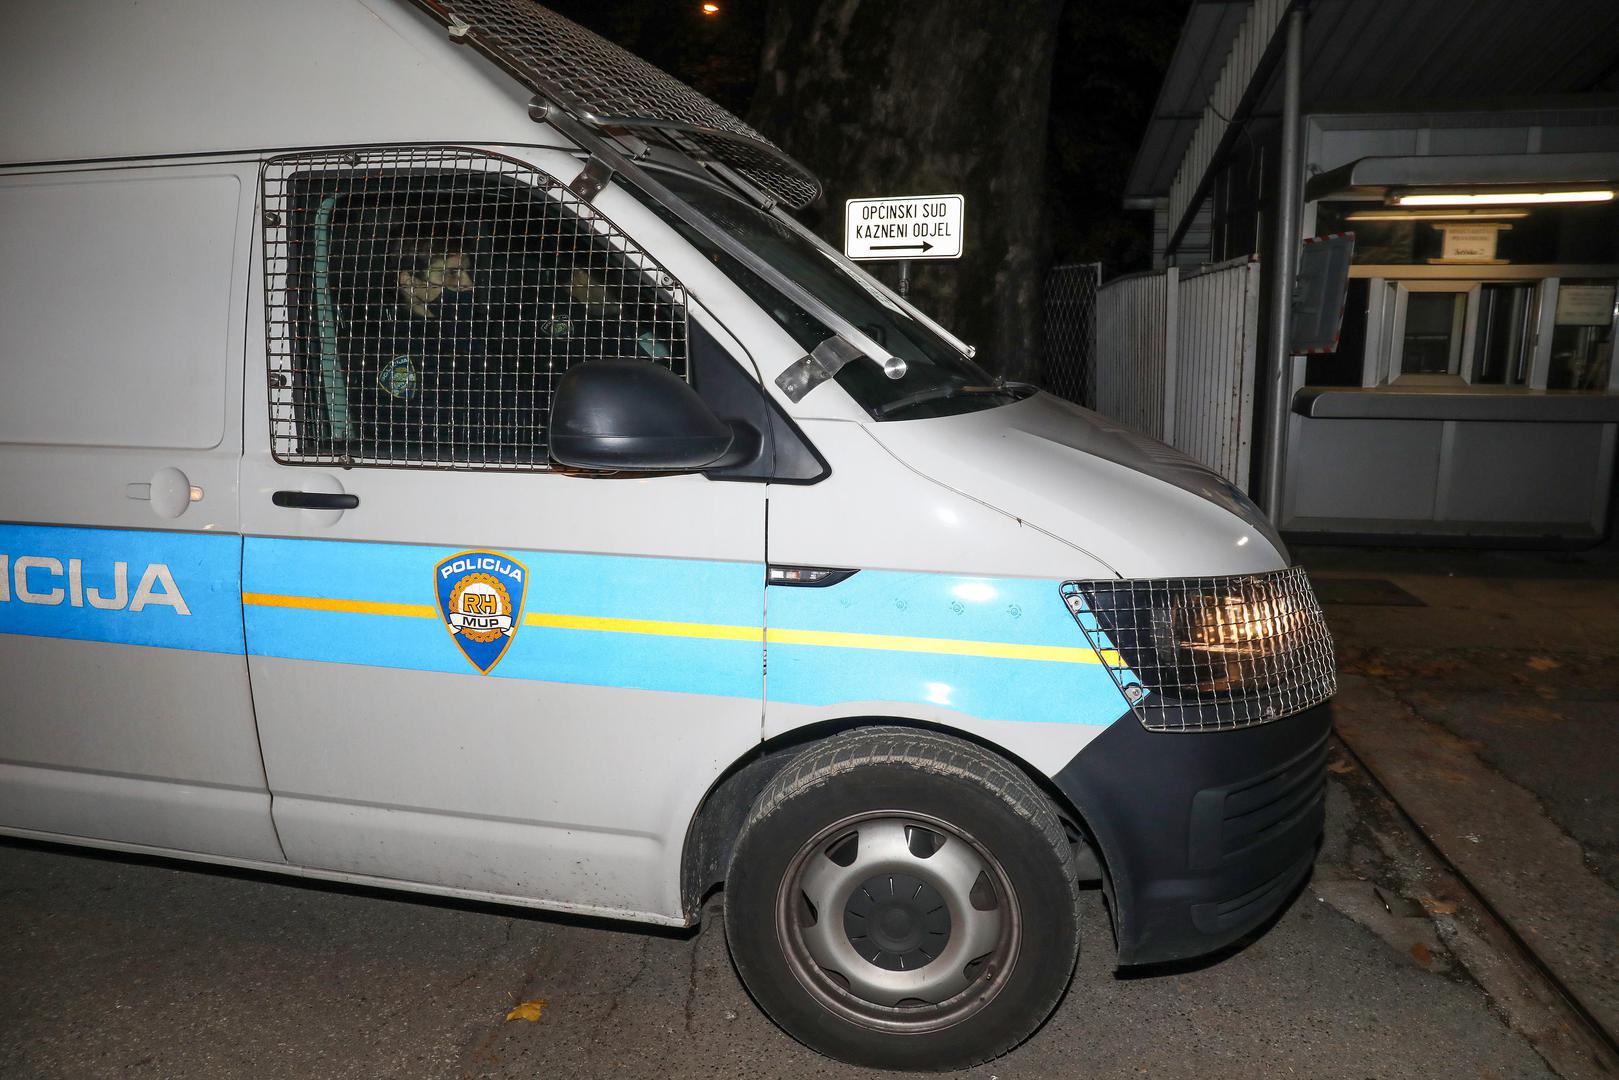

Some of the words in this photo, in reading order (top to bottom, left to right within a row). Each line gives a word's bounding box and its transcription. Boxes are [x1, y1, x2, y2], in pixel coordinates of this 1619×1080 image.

[862, 202, 917, 220] OPĆINSKI
[922, 203, 947, 218] SUD
[856, 224, 908, 239] KAZNENI
[913, 222, 951, 238] ODJEL
[441, 558, 521, 582] POLICIJA
[462, 593, 497, 614] RH
[462, 616, 499, 628] MUP
